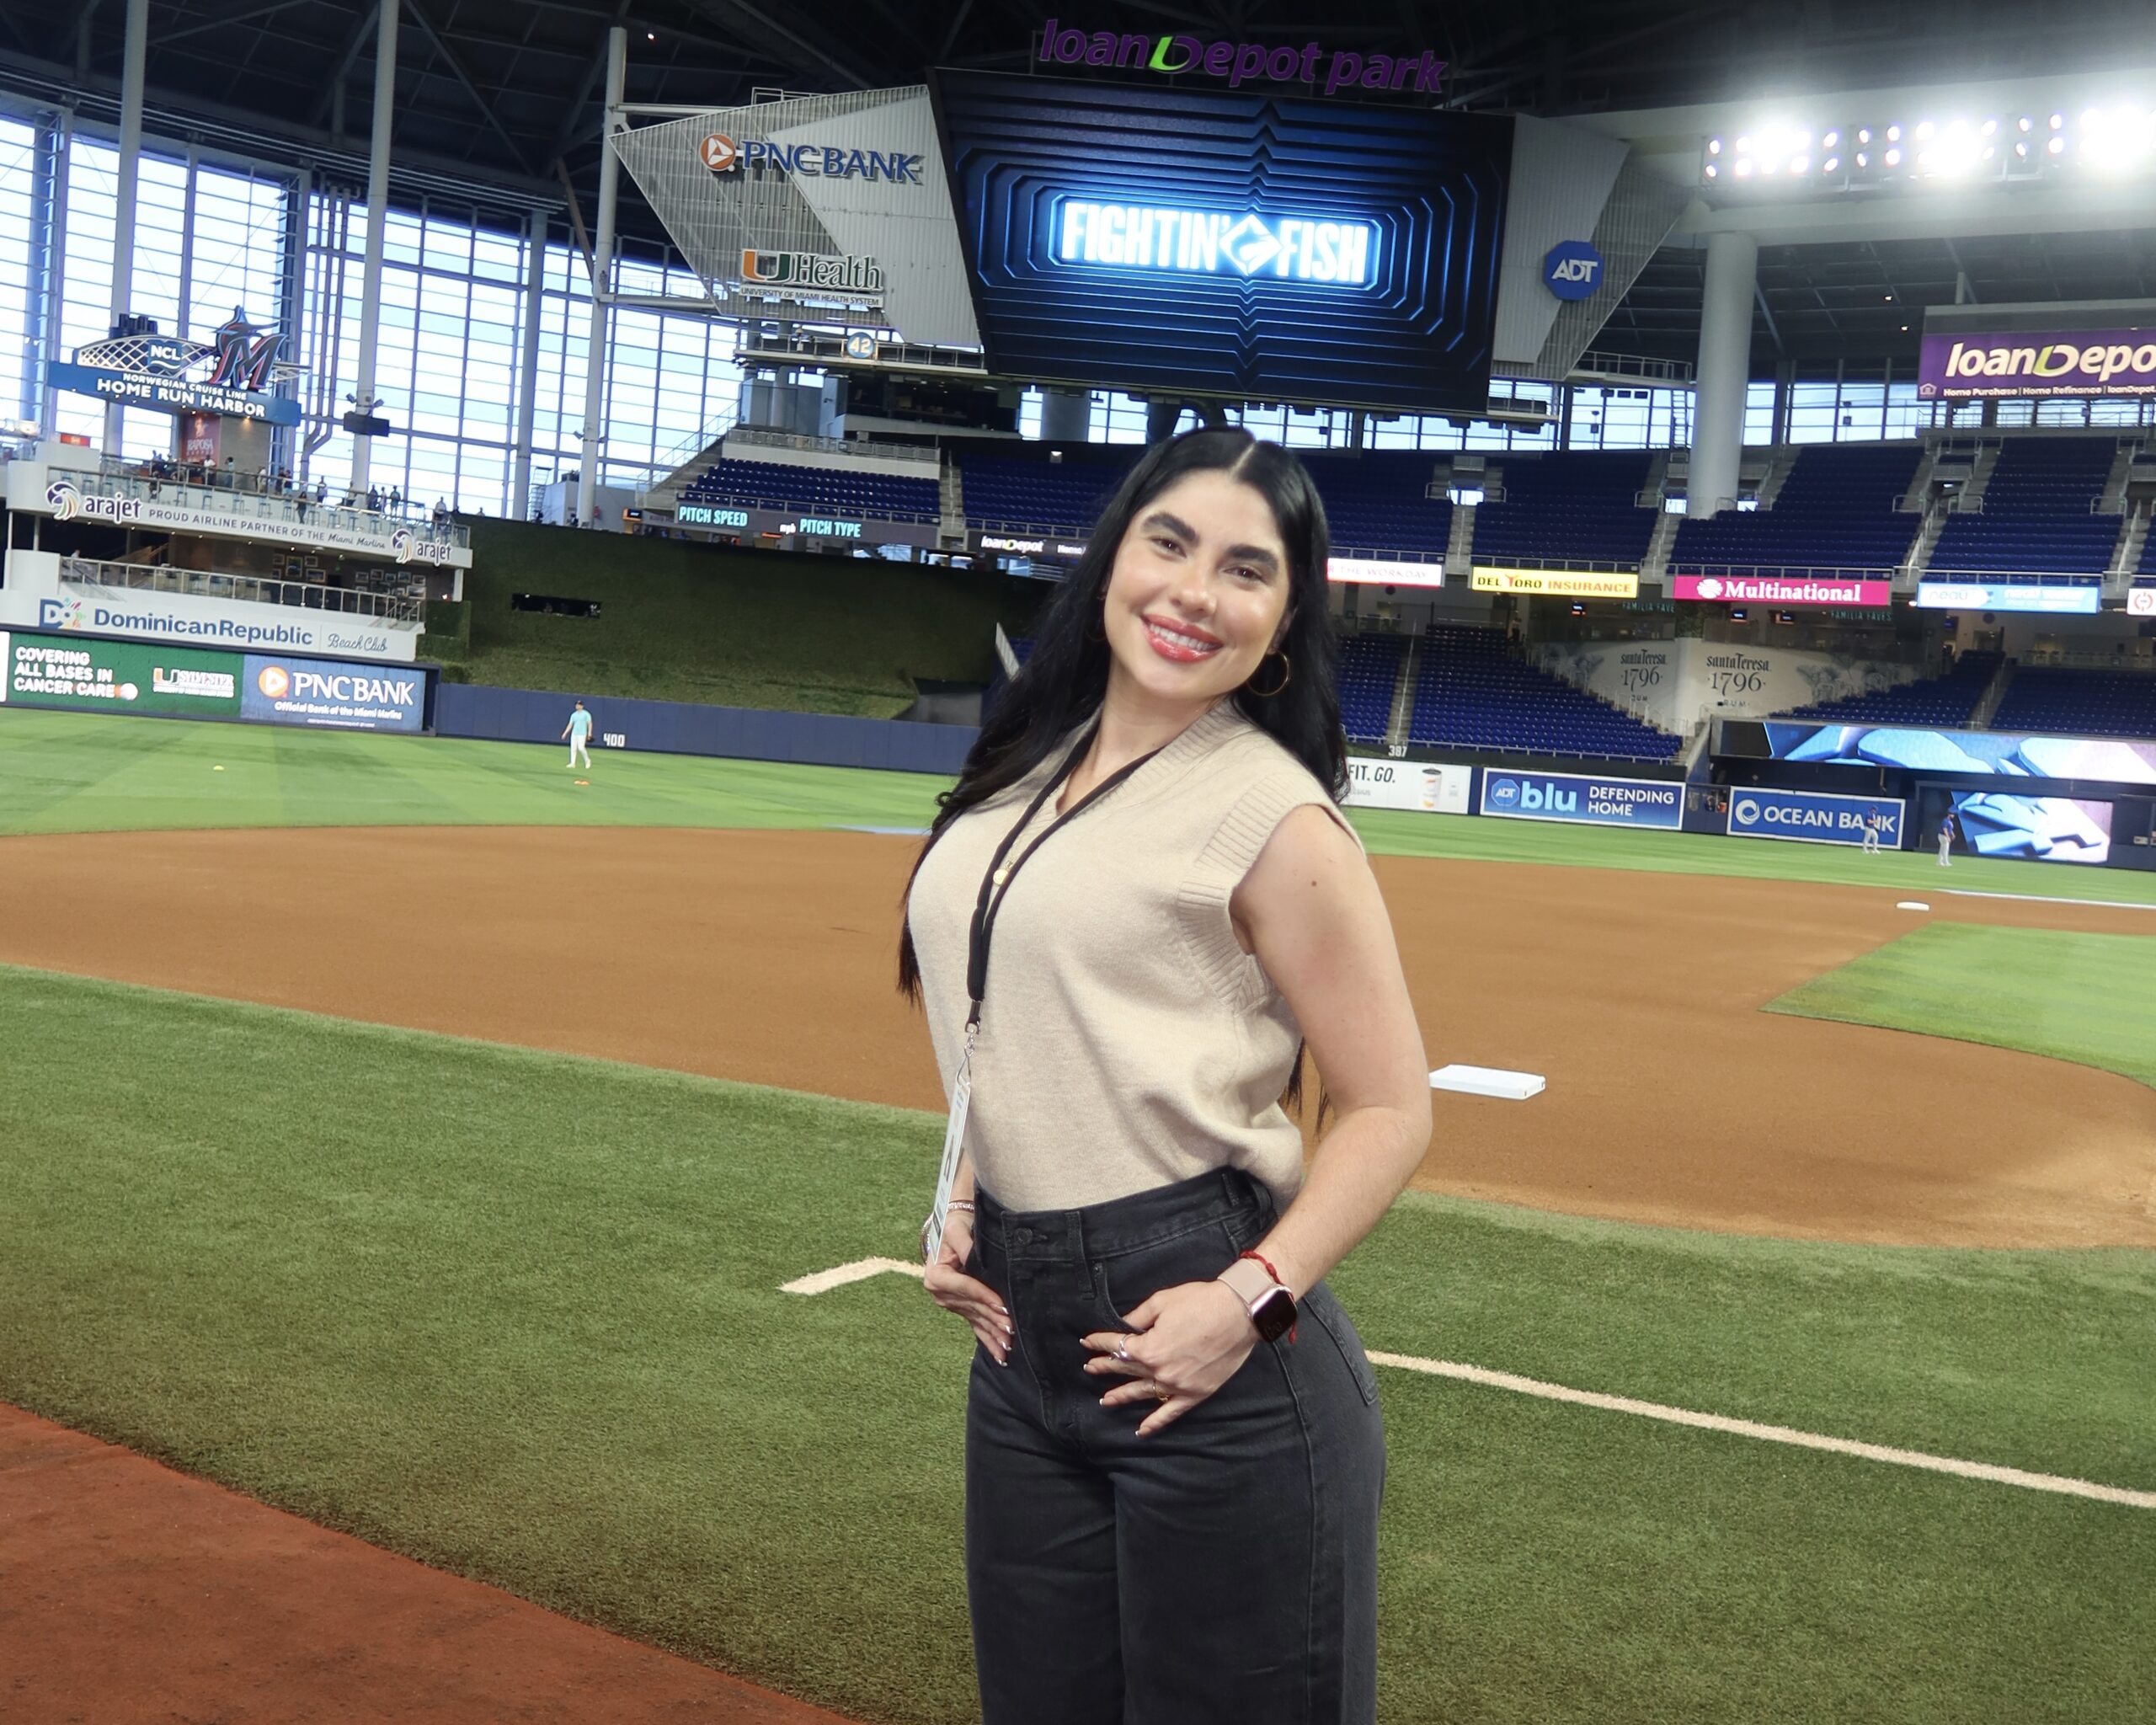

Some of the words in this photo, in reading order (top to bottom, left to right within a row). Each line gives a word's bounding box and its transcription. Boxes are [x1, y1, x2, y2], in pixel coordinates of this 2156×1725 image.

[1039, 19, 1322, 88] loanDepot
[1325, 50, 1450, 95] park
[1276, 218, 1369, 283] FISH
[1550, 259, 1598, 283] ADT
[740, 287, 783, 297] UNIVERSITY
[795, 291, 820, 301] MIAMI
[821, 294, 849, 303] HEALTH
[850, 296, 879, 306] SYSTEM
[151, 344, 181, 360] NCL
[848, 336, 871, 354] 42
[123, 373, 186, 391] NORWEGIAN
[189, 382, 223, 397] CRUISE
[226, 389, 248, 401] LINE
[1943, 387, 1972, 397] Home
[1972, 387, 2018, 397] Purchase
[2022, 387, 2052, 396] Home
[2052, 385, 2102, 395] Refinance
[97, 378, 152, 398] HOME
[157, 387, 195, 404] RUN
[200, 394, 266, 418] HARBOR
[85, 494, 141, 521] arajet
[679, 506, 712, 523] PITCH
[713, 510, 749, 526] SPEED
[149, 509, 189, 522] PROUD
[192, 515, 237, 529] AIRLINE
[240, 521, 288, 536] PARTNER
[291, 528, 304, 538] OF
[307, 531, 325, 541] THE
[328, 533, 354, 546] Miami
[355, 537, 385, 549] Marlins
[799, 518, 833, 535] PITCH
[834, 521, 862, 537] TYPE
[417, 539, 452, 565] arajet
[1477, 575, 1502, 587] DEL
[1505, 574, 1542, 589] TORO
[1548, 579, 1632, 594] INSURANCE
[1724, 580, 1861, 602] Multinational
[328, 633, 364, 649] Beach
[364, 636, 388, 652] Club
[15, 646, 91, 666] COVERING
[14, 661, 42, 677] ALL
[45, 663, 94, 681] BASES
[97, 668, 113, 683] IN
[13, 676, 74, 696] CANCER
[76, 681, 116, 699] CARE
[275, 701, 307, 713] Official
[307, 703, 329, 714] Bank
[603, 733, 626, 748] 400
[1388, 745, 1408, 758] 387
[1374, 766, 1396, 784] GO.
[1495, 787, 1516, 799] ADT
[1520, 781, 1577, 812] blu
[1589, 786, 1675, 804] DEFENDING
[1588, 801, 1633, 817] HOME
[1764, 806, 1833, 828] OCEAN
